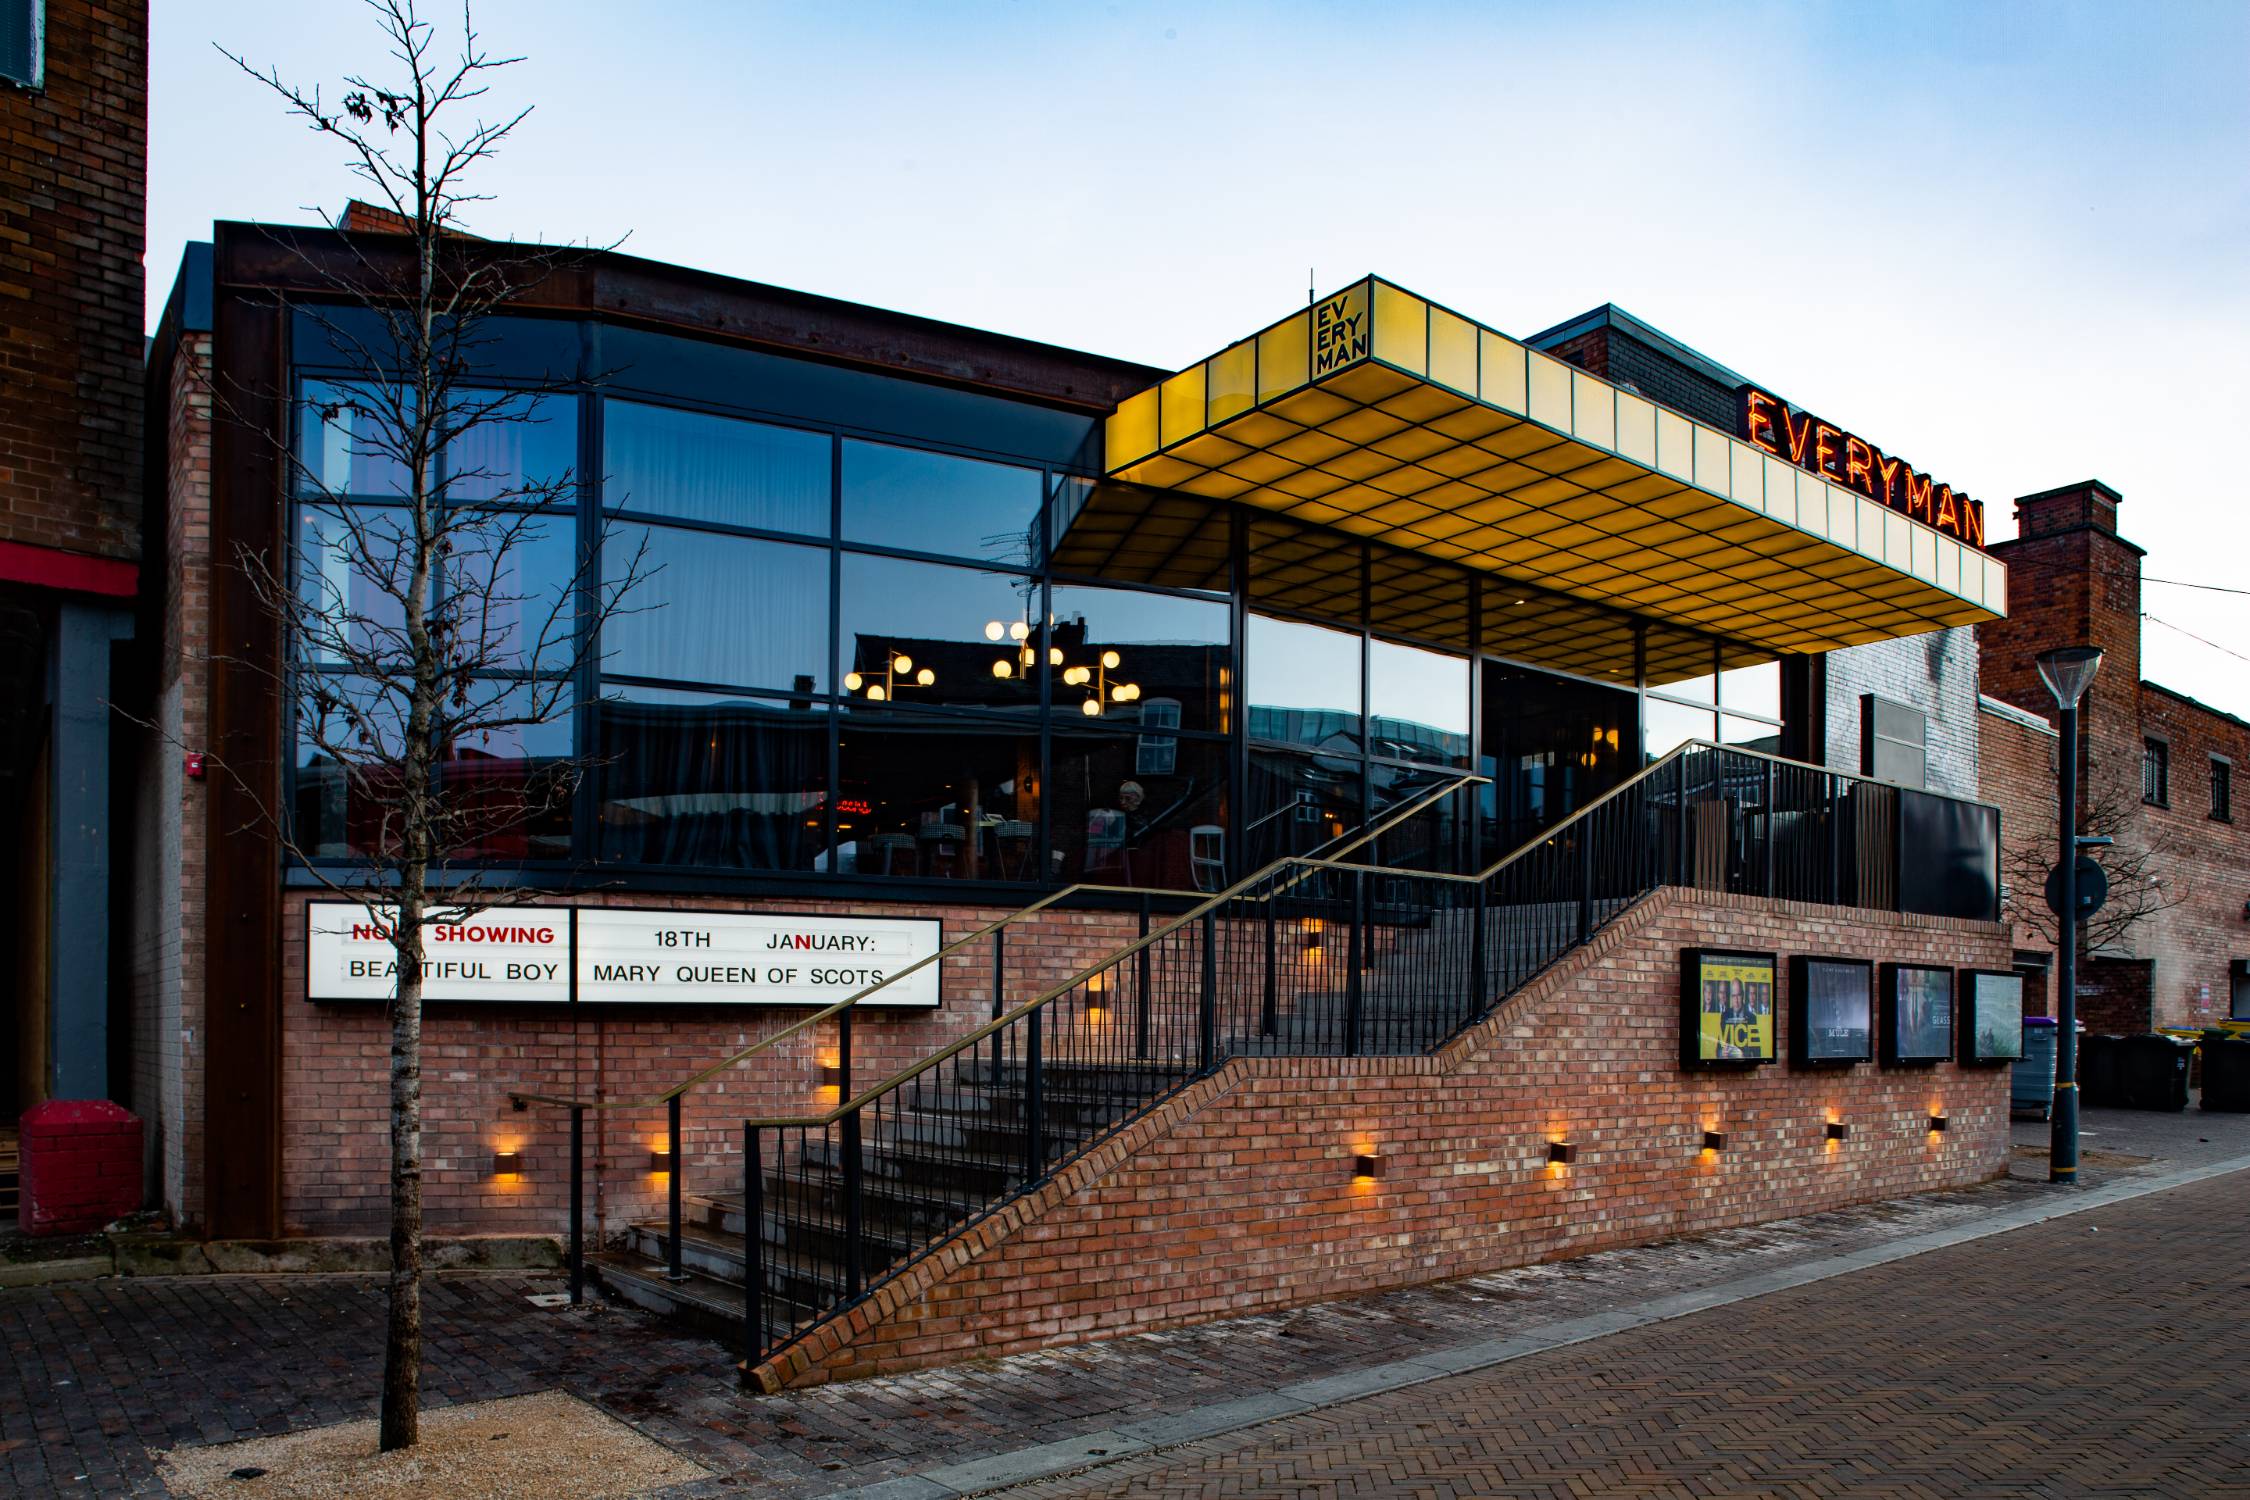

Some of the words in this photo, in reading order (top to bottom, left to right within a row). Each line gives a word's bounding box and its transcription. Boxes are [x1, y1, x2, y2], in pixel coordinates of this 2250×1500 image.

[1317, 295, 1348, 329] EV
[1317, 312, 1363, 352] ERY
[1316, 333, 1366, 375] MAN
[1741, 385, 1984, 549] EVERYMAN
[352, 923, 400, 942] NO
[434, 925, 555, 944] SHOWING
[655, 931, 711, 947] 18TH
[766, 934, 875, 952] JANUARY:
[349, 960, 491, 979] BEATIFUL
[507, 963, 559, 981] BOY
[594, 965, 661, 982] MARY
[676, 966, 757, 983] QUEEN
[767, 968, 798, 984] OF
[810, 969, 885, 985] SCOTS
[1718, 1023, 1761, 1048] VICE
